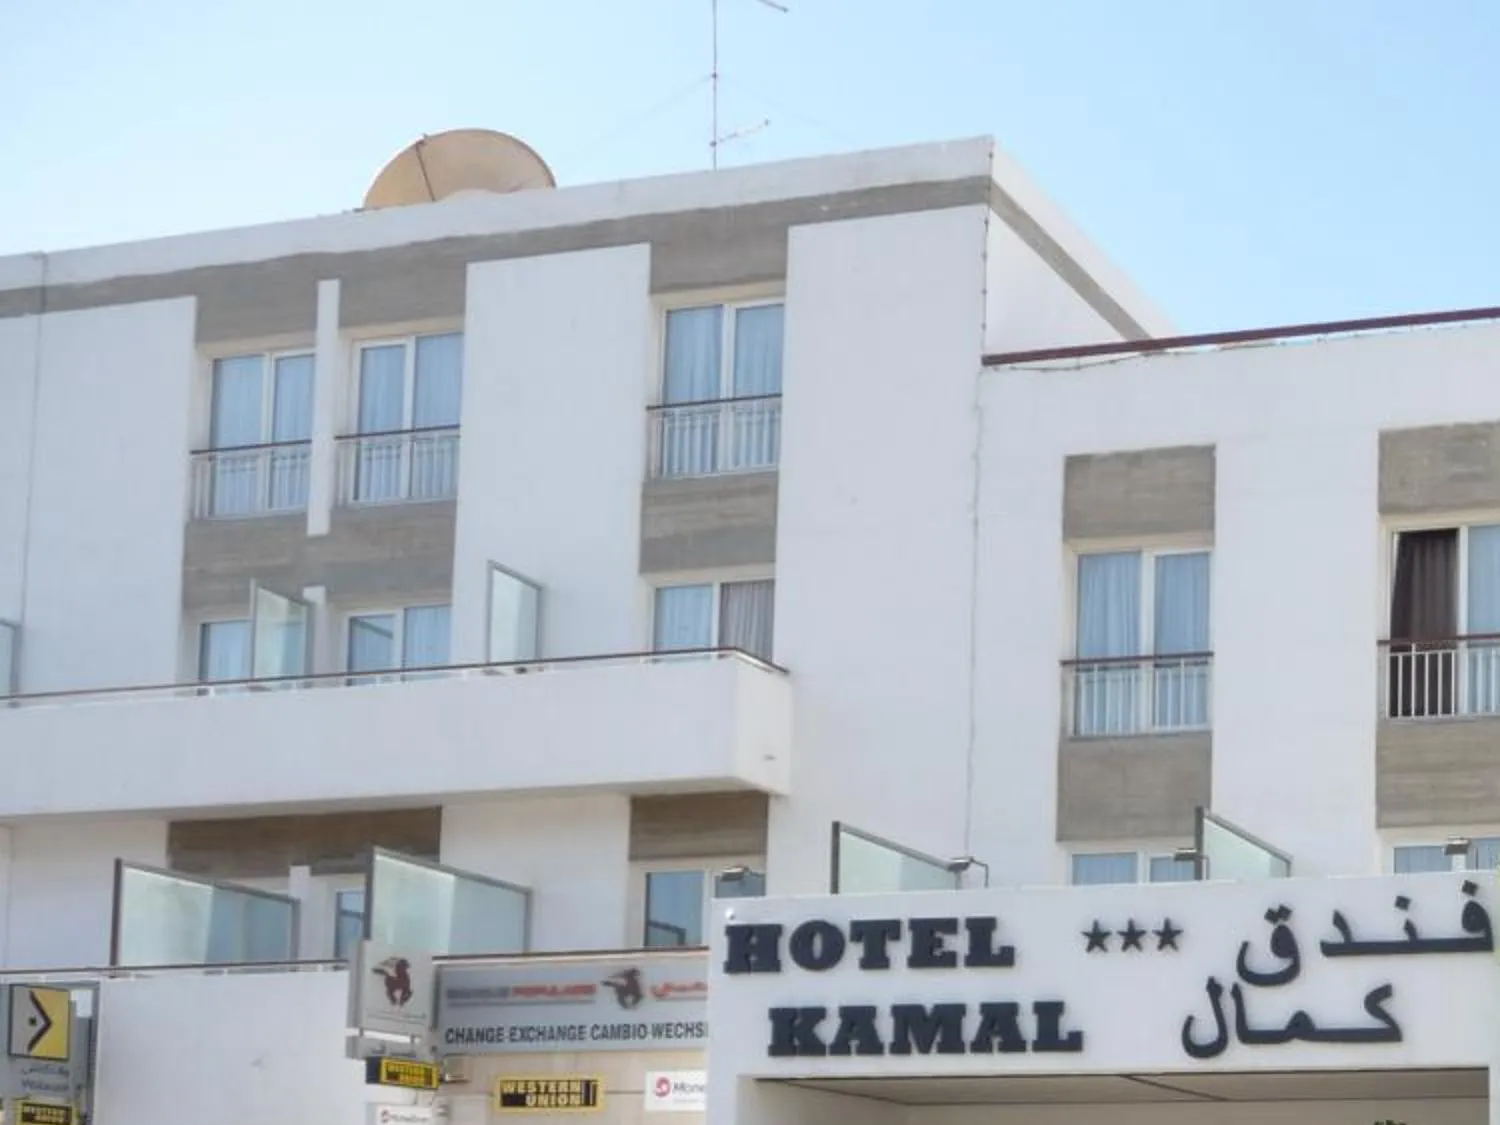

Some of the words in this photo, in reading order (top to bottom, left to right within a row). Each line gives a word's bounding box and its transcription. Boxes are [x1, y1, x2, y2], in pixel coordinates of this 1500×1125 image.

[724, 916, 1015, 973] HOTEL
[1237, 879, 1494, 986] فندق
[445, 1027, 505, 1044] CHANGE
[509, 1024, 587, 1042] EXCHANGE
[591, 1023, 648, 1041] CAMBIO
[651, 1021, 708, 1039] WECHS
[768, 1000, 1084, 1057] KAMAL
[1181, 975, 1403, 1059] كمال
[501, 1080, 581, 1094] WESTERN
[525, 1093, 581, 1106] UNION
